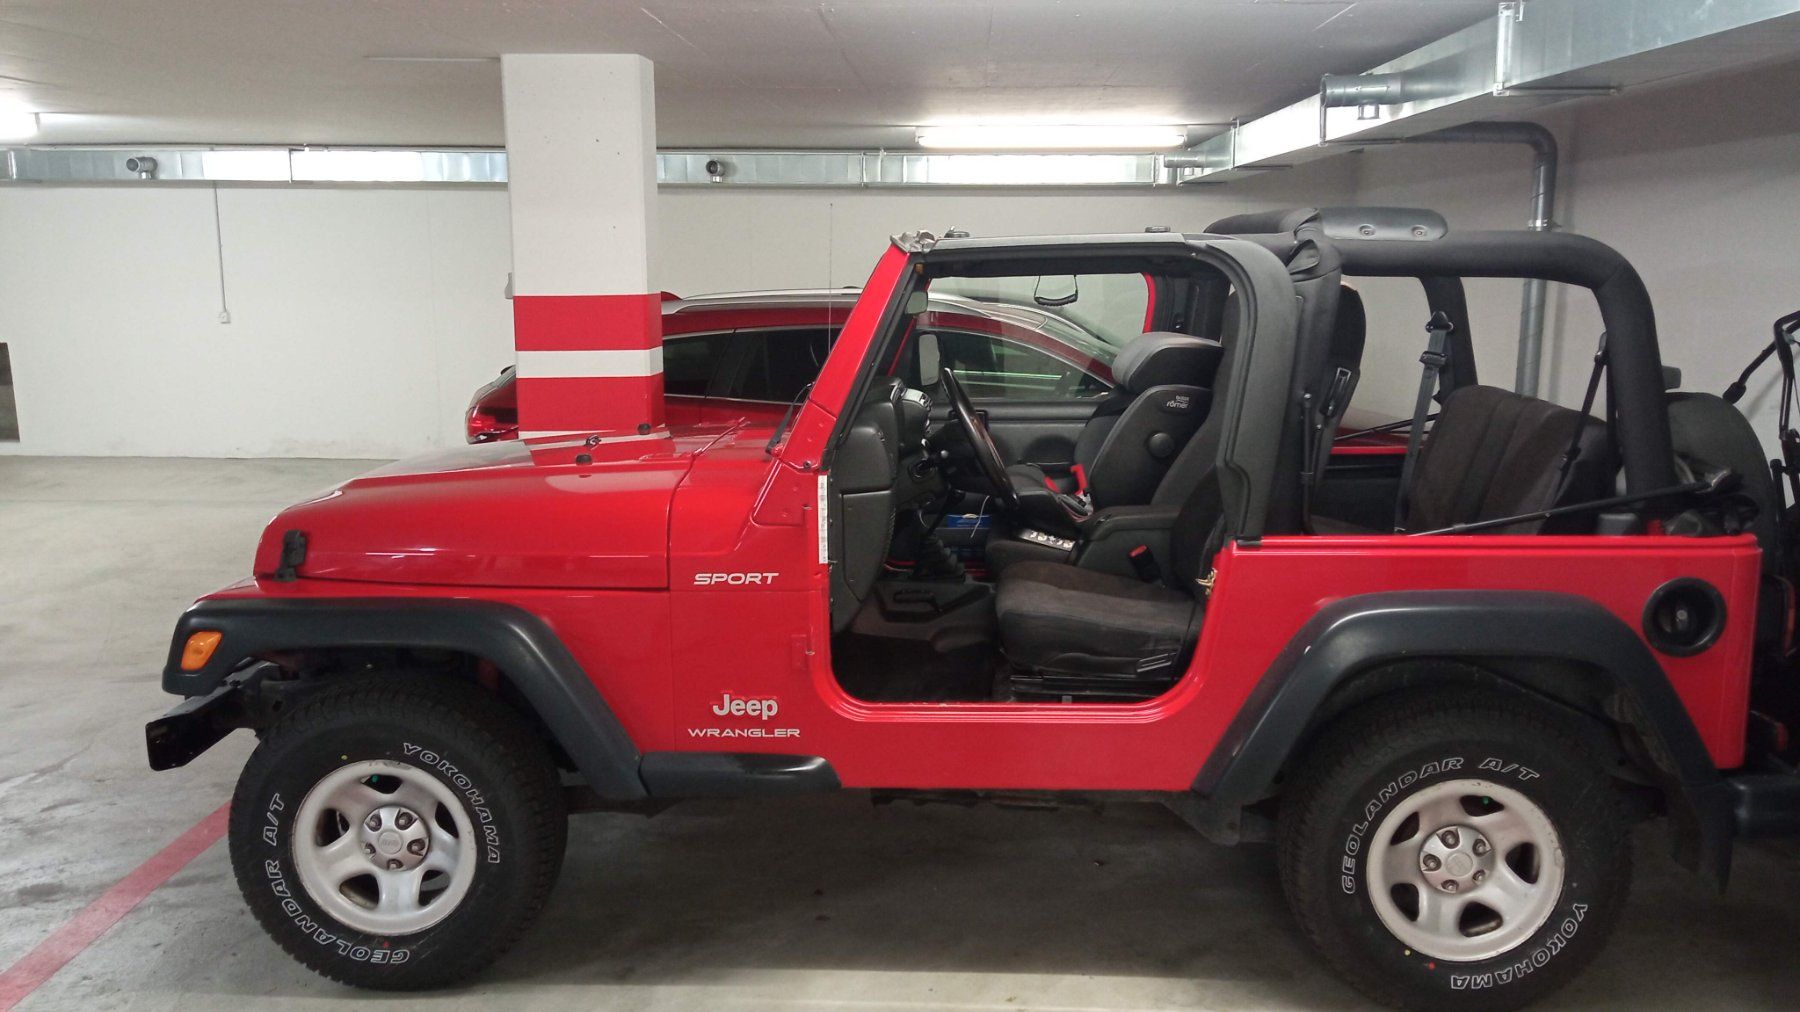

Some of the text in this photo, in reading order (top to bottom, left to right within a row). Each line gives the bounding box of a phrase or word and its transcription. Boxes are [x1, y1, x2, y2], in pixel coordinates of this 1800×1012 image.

[693, 572, 780, 585] SPORT
[688, 728, 801, 738] WRANGLER
[712, 693, 778, 721] Jeep
[402, 742, 500, 863] YOKOHAMA
[1341, 757, 1541, 894] GEOLANDAR A/T
[262, 792, 410, 964] GEOLANDAR A/T
[1451, 903, 1588, 990] YOKOHAMA
